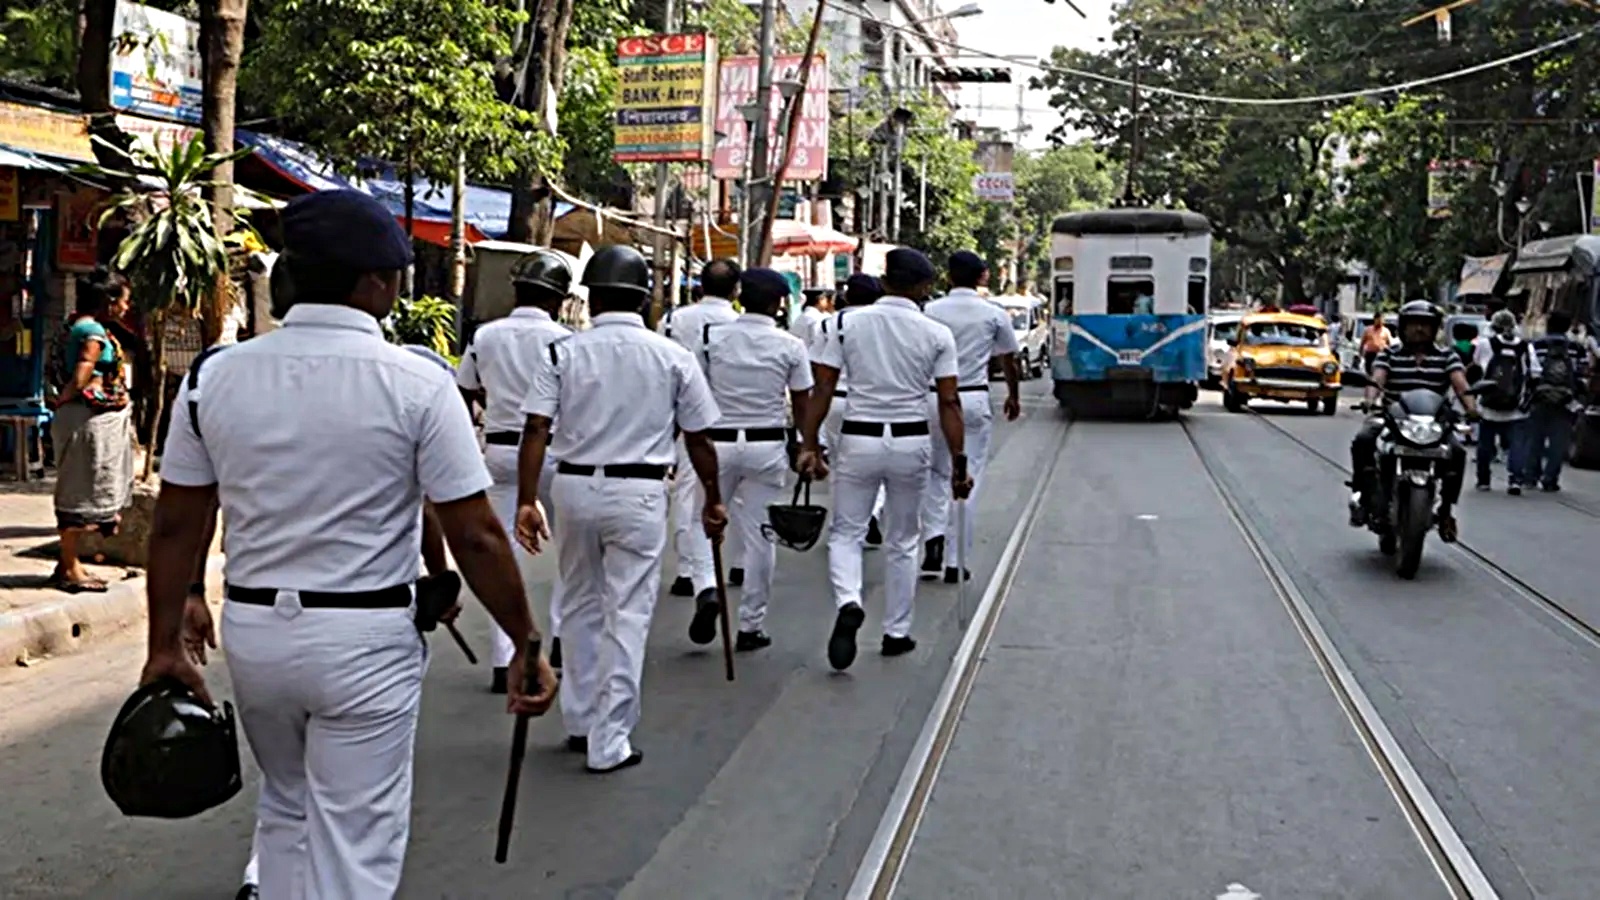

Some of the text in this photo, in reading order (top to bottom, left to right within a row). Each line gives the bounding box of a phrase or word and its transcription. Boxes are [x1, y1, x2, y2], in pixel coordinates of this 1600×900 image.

[619, 34, 703, 56] GSCE
[623, 65, 703, 83] Staff Selection
